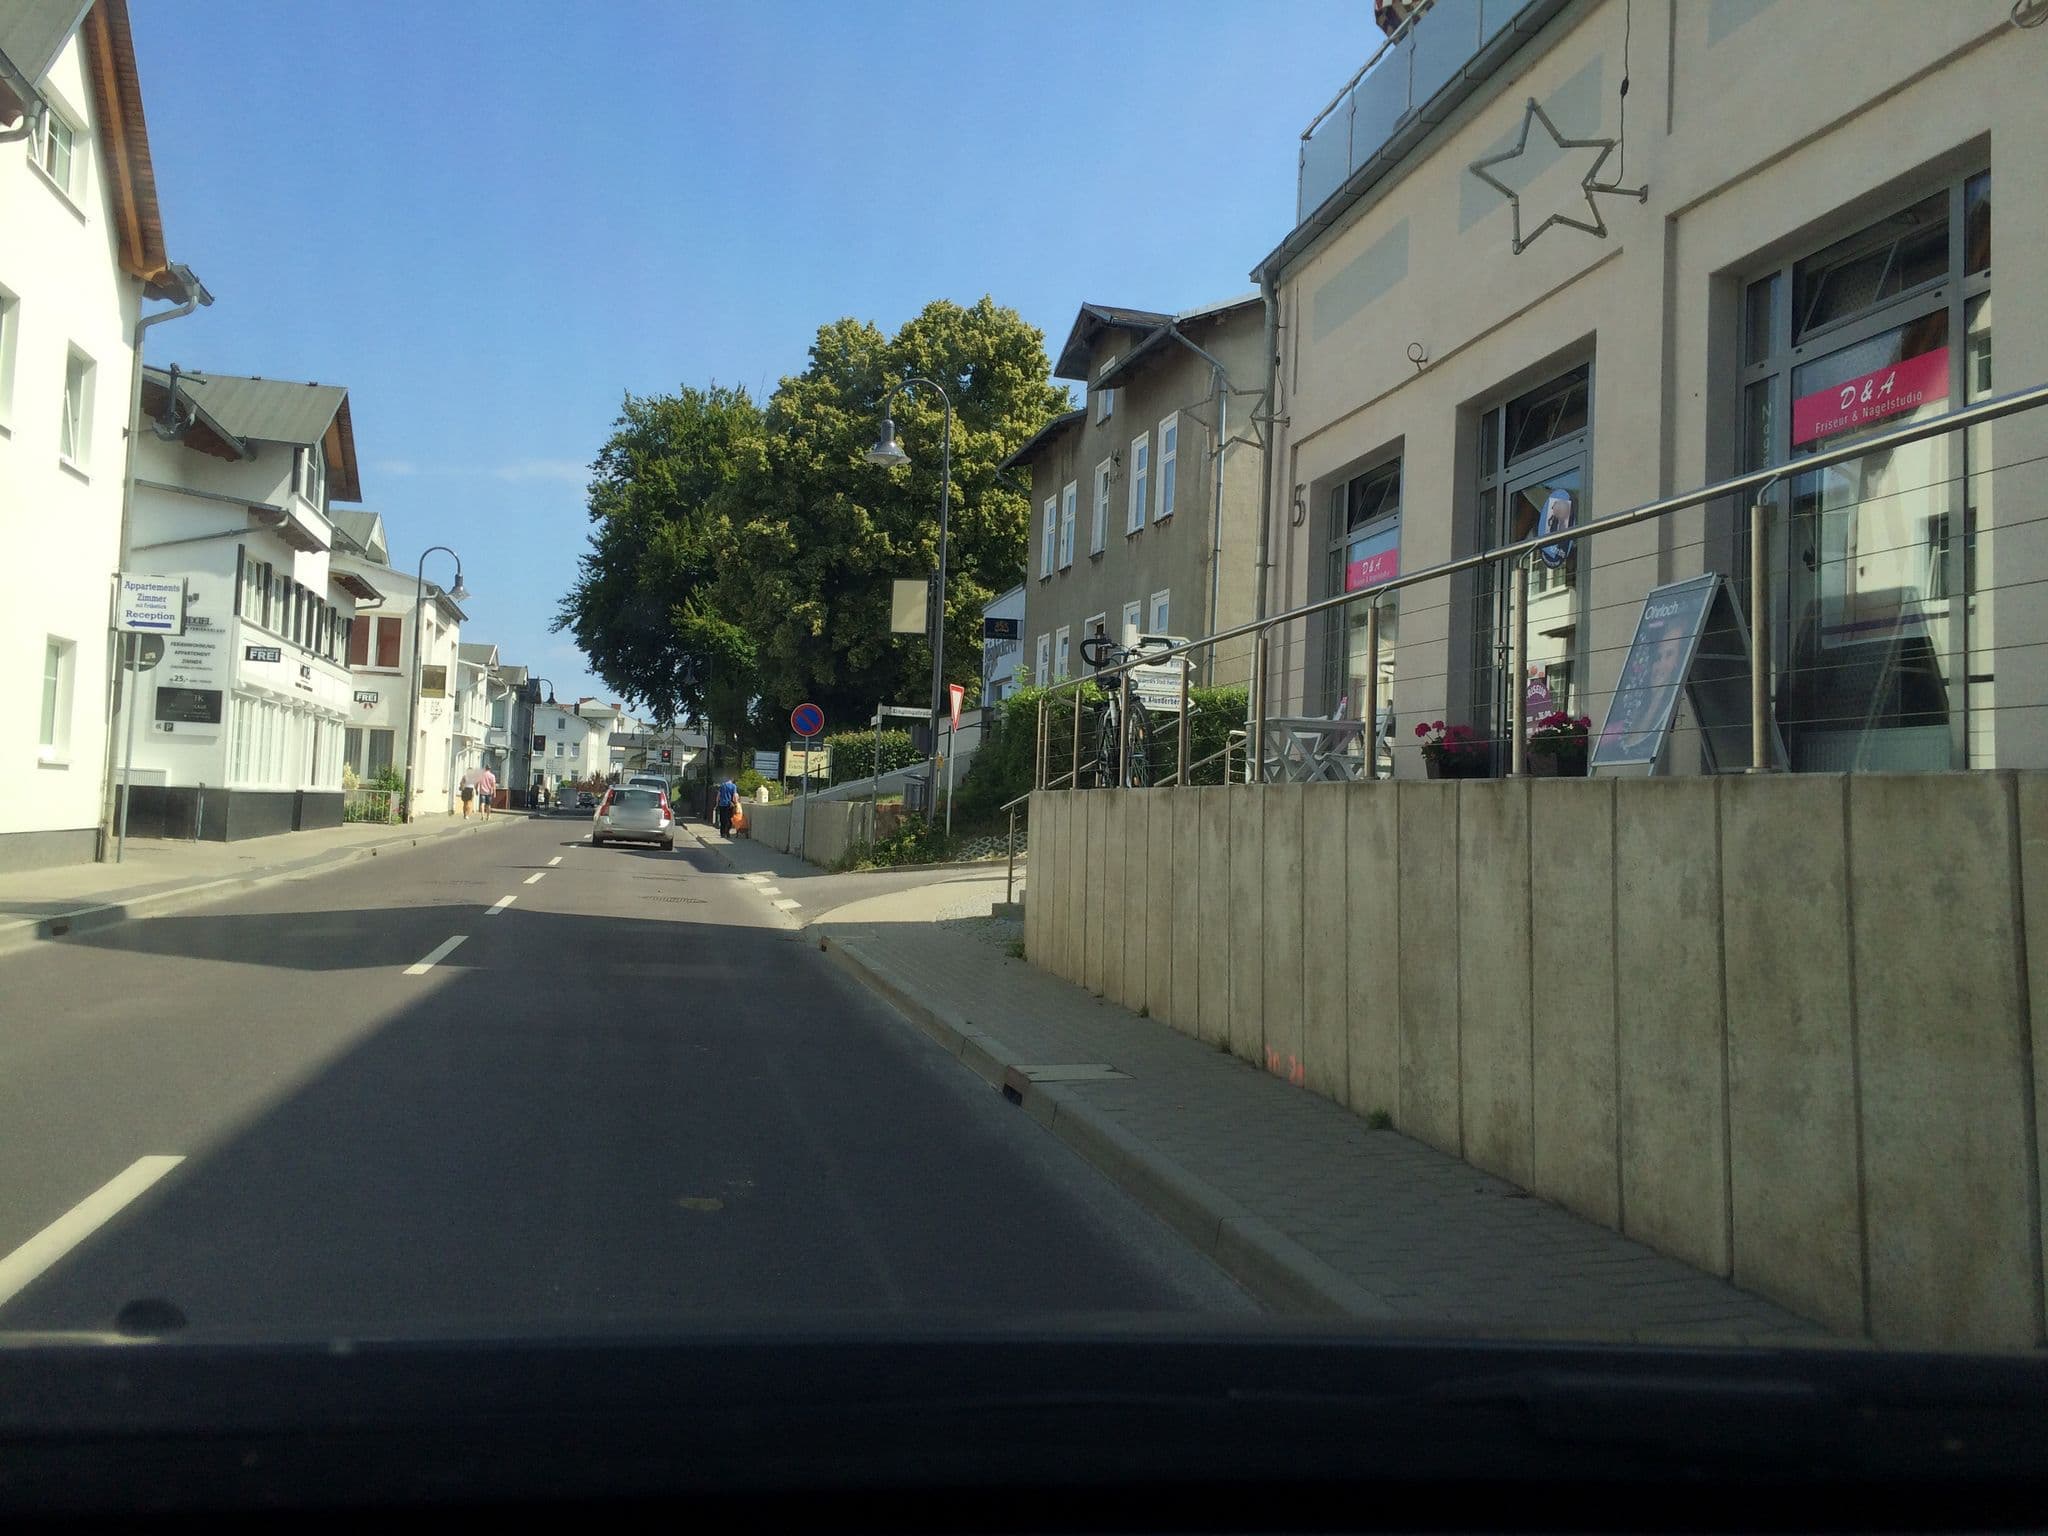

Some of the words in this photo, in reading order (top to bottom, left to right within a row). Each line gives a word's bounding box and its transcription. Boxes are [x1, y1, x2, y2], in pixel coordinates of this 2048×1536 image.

[1840, 386, 1856, 410] D
[1860, 379, 1873, 402] &
[1877, 371, 1896, 399] A
[1815, 415, 1848, 434] Friseur
[1852, 410, 1858, 422] &
[1862, 391, 1923, 418] Nagelstudio
[125, 581, 180, 592] Appartements
[136, 593, 167, 602] Zimmer
[125, 609, 175, 620] Reception
[249, 650, 279, 661] FREI
[356, 694, 377, 702] FREI
